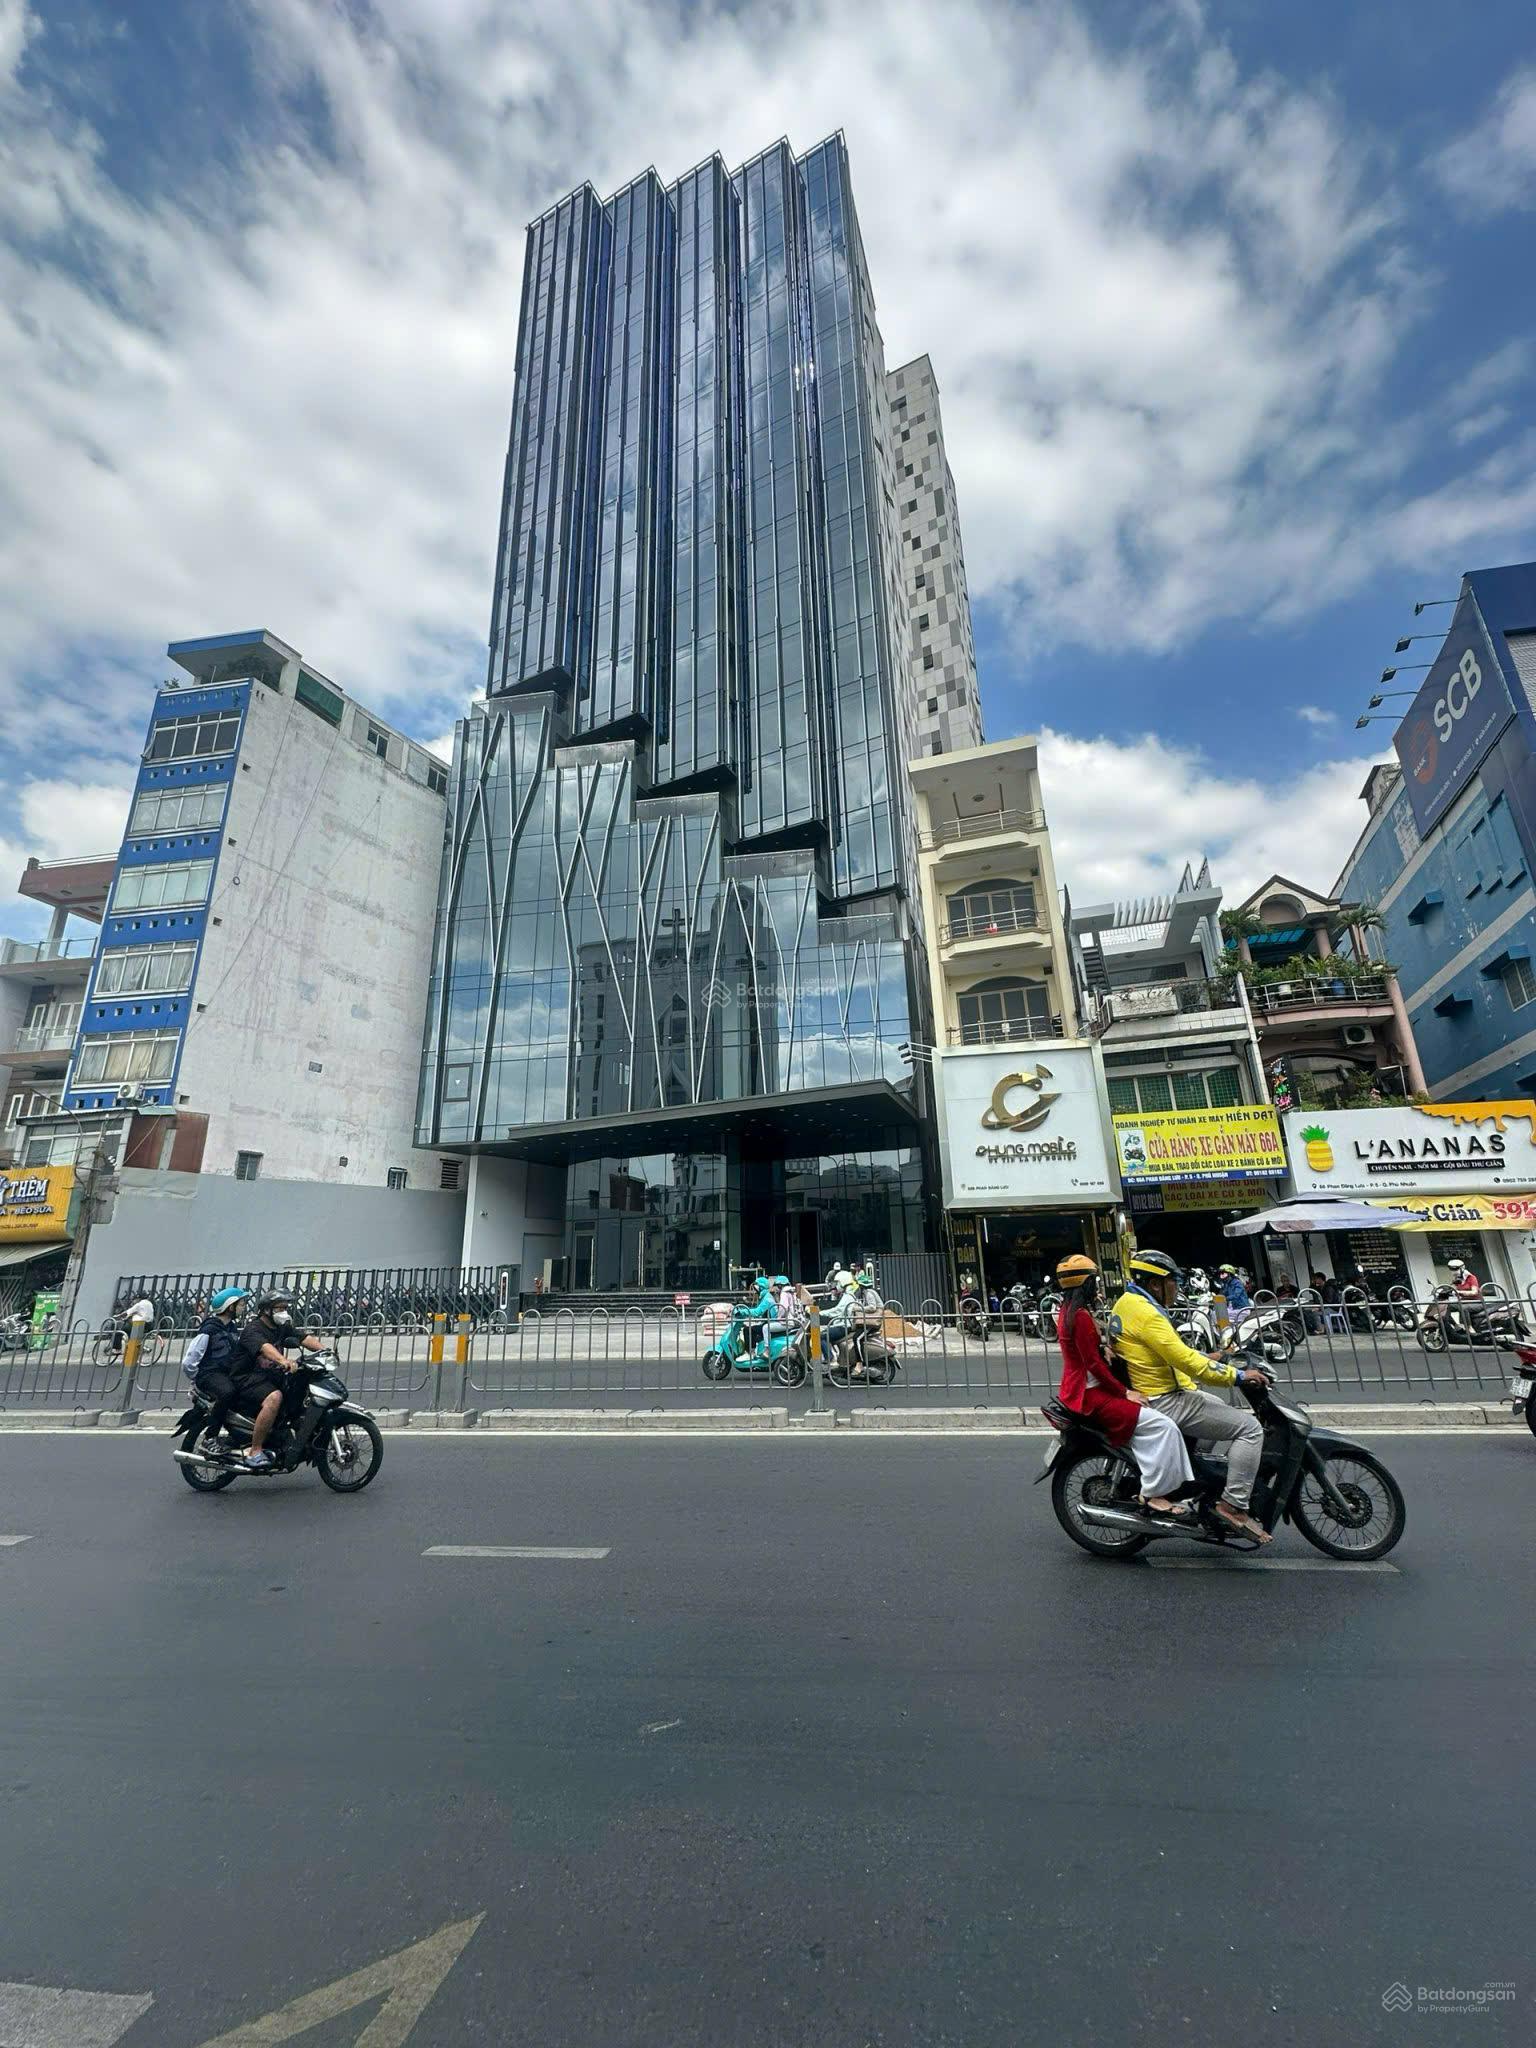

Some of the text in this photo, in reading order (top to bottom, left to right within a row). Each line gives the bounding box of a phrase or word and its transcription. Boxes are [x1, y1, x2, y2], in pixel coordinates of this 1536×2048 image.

[1434, 649, 1482, 743] SCB
[1169, 1132, 1198, 1157] HÀNG
[1198, 1136, 1213, 1156] XE
[1236, 1128, 1257, 1154] MÁY
[1259, 1132, 1279, 1152] 66A
[1227, 1159, 1234, 1167] XE
[1235, 1159, 1239, 1167] 2
[1238, 1189, 1244, 1197] &
[1432, 1203, 1483, 1221] Giãn
